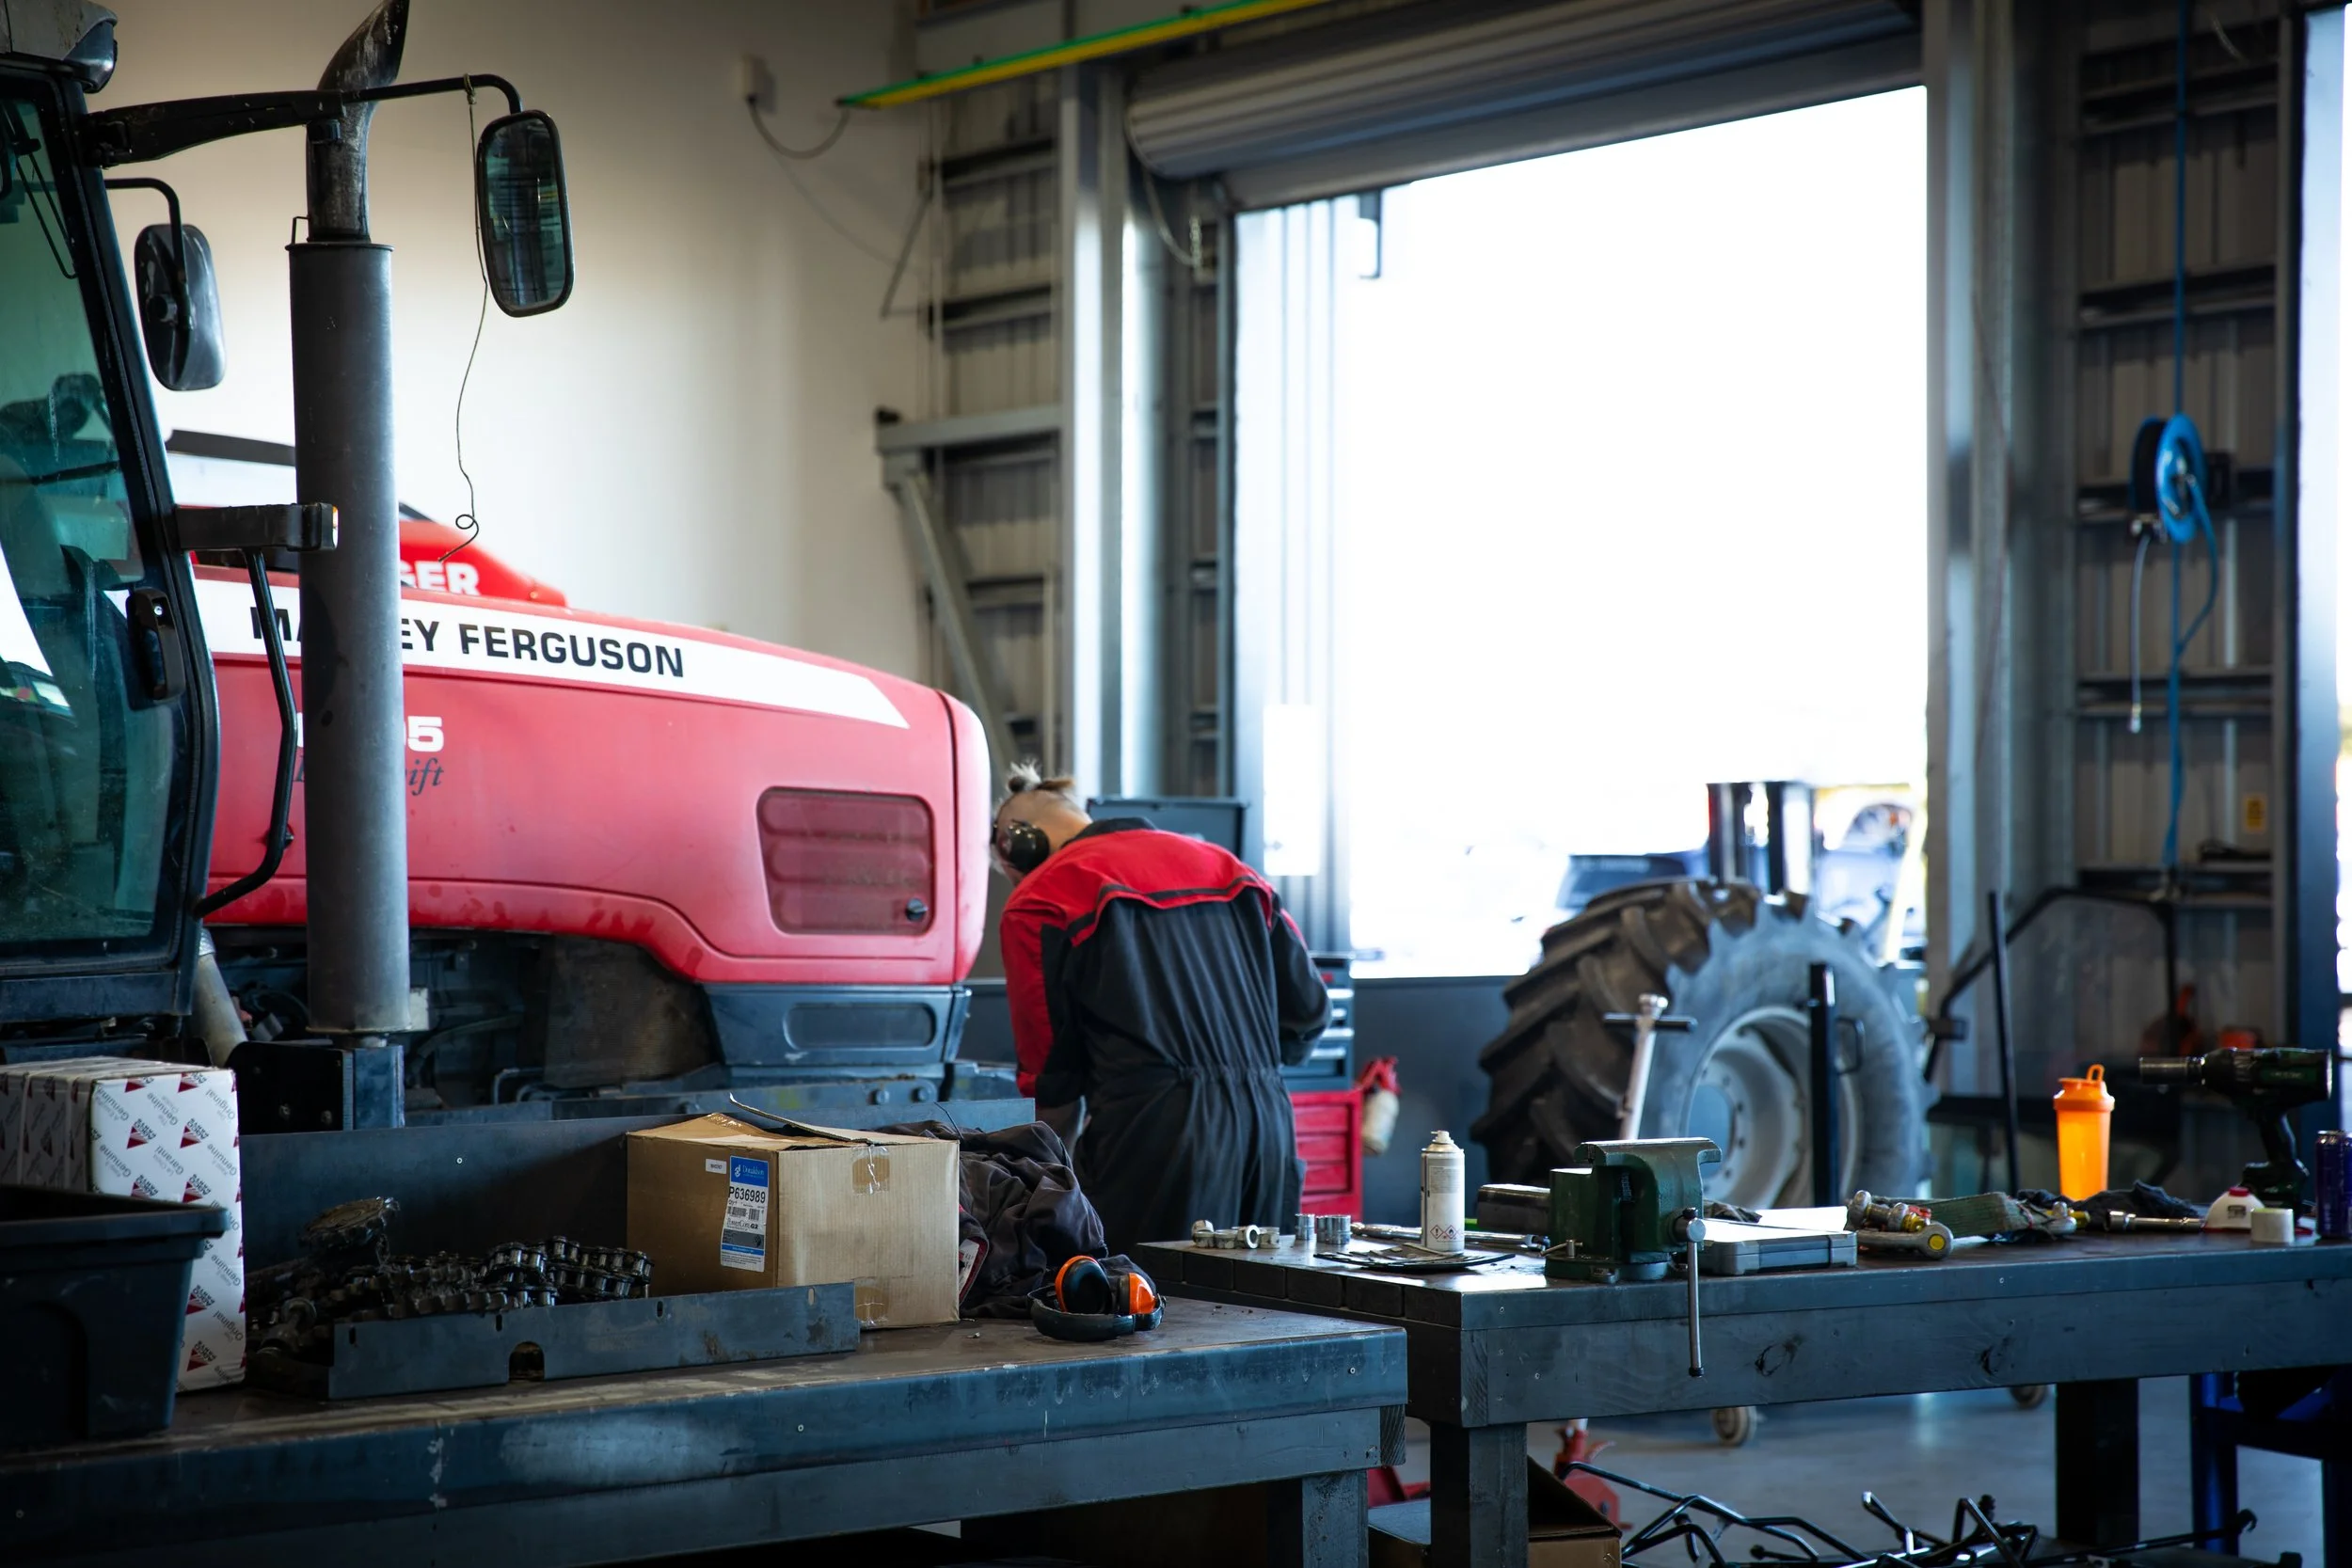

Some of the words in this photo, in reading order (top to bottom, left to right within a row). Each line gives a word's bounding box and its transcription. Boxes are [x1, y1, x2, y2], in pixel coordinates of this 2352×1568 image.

[458, 623, 684, 678] FERGUSON
[146, 1093, 179, 1125] Genuine
[206, 1089, 235, 1119] Original
[99, 1145, 131, 1177] Genuine
[207, 1144, 238, 1174] Genuine
[728, 1186, 766, 1203] P636989
[211, 1256, 241, 1285] Genuine
[214, 1311, 243, 1341] Original
